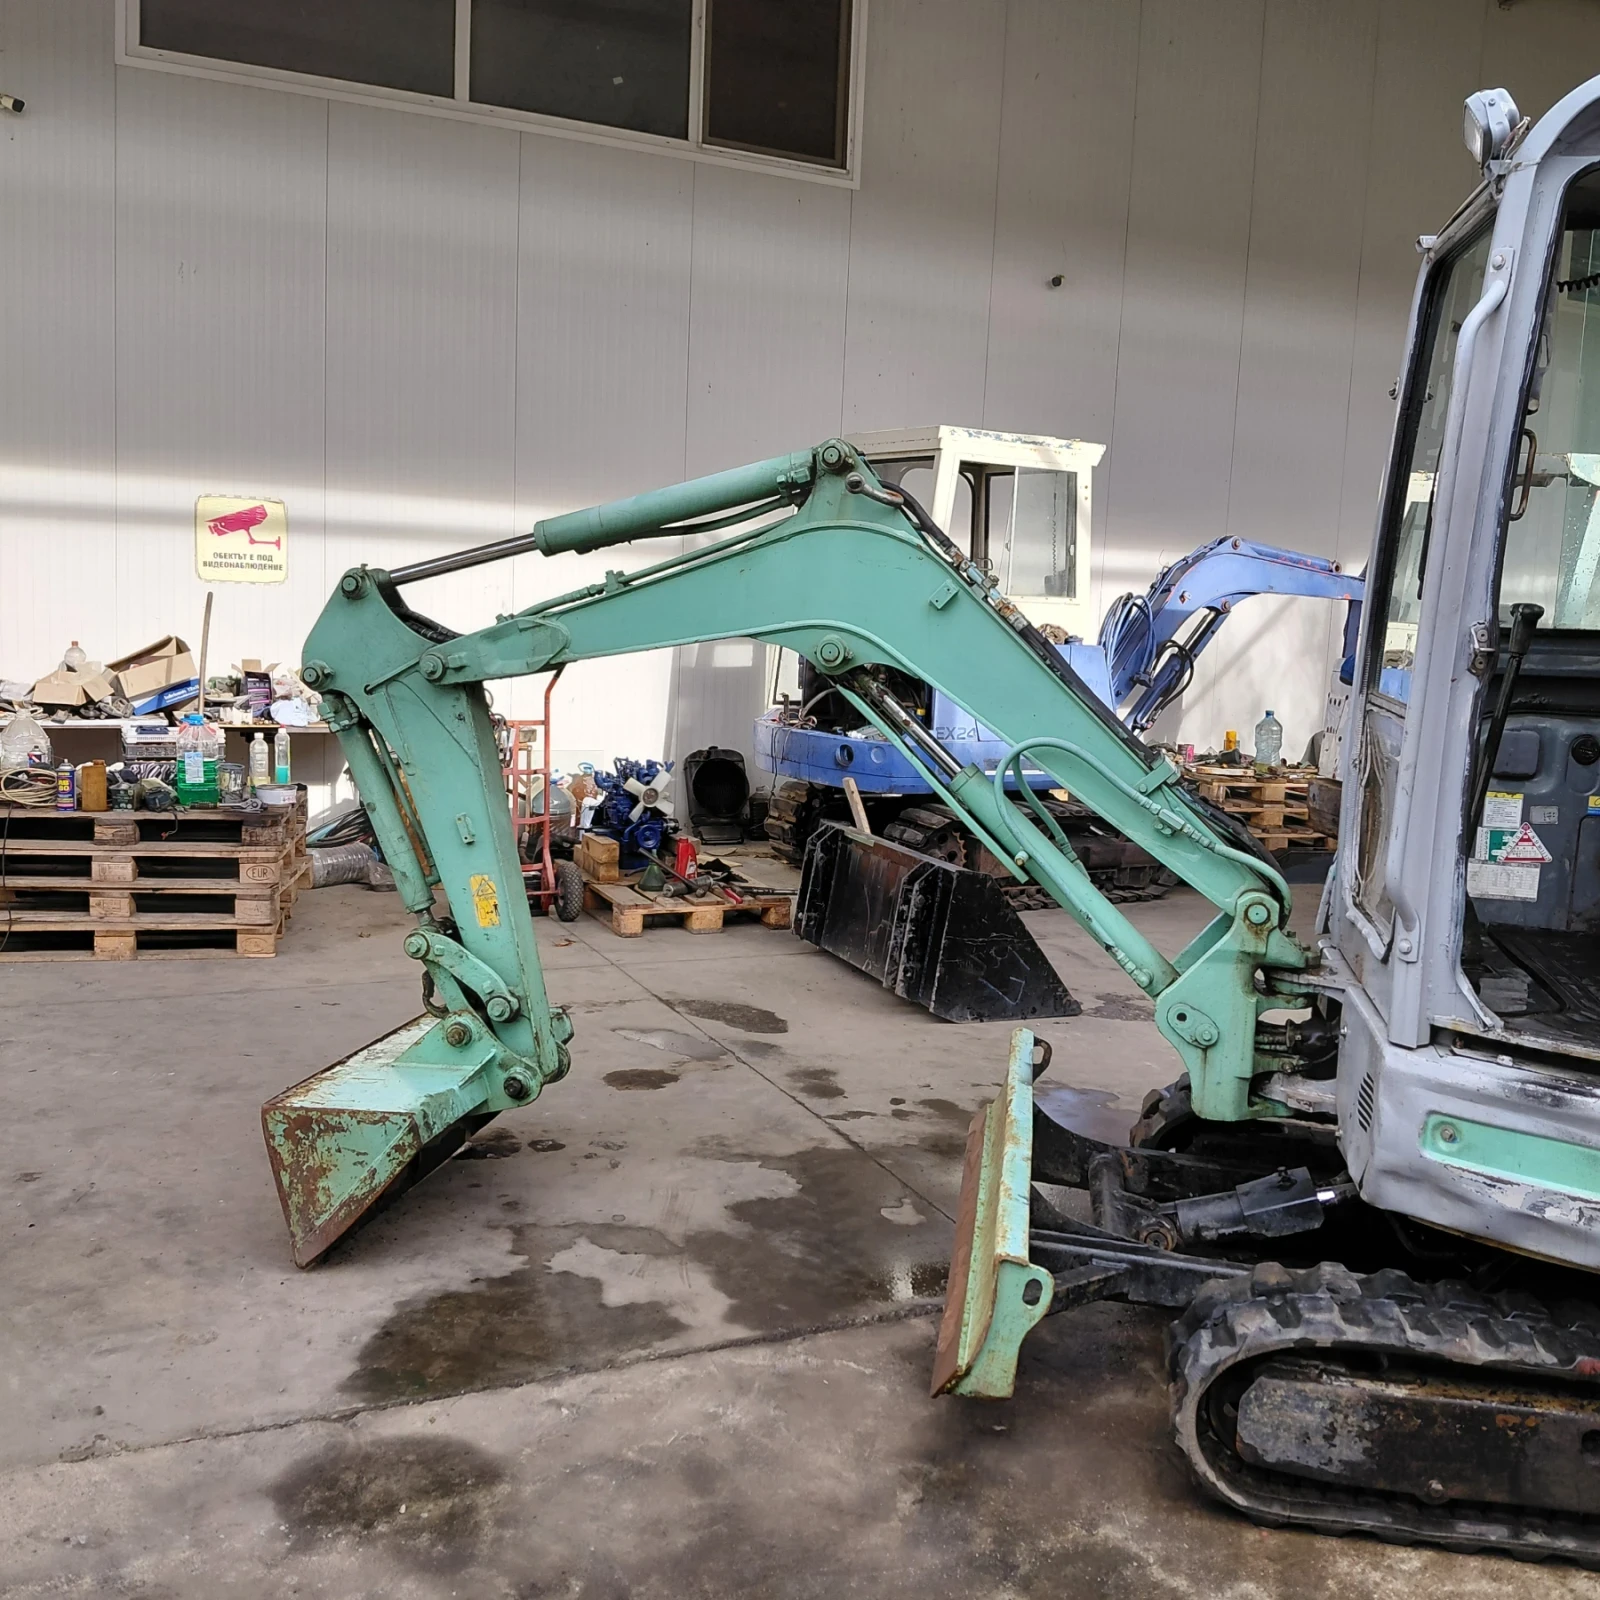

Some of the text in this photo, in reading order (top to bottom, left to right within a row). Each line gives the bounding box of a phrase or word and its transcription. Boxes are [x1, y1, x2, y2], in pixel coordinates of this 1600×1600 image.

[213, 552, 247, 561] ОБЕКТЪТ
[256, 554, 273, 562] ПОД
[202, 560, 284, 571] ВИДЕОНАБЛЮДЕНИЕ
[935, 726, 976, 740] EX24
[251, 867, 268, 878] EUR
